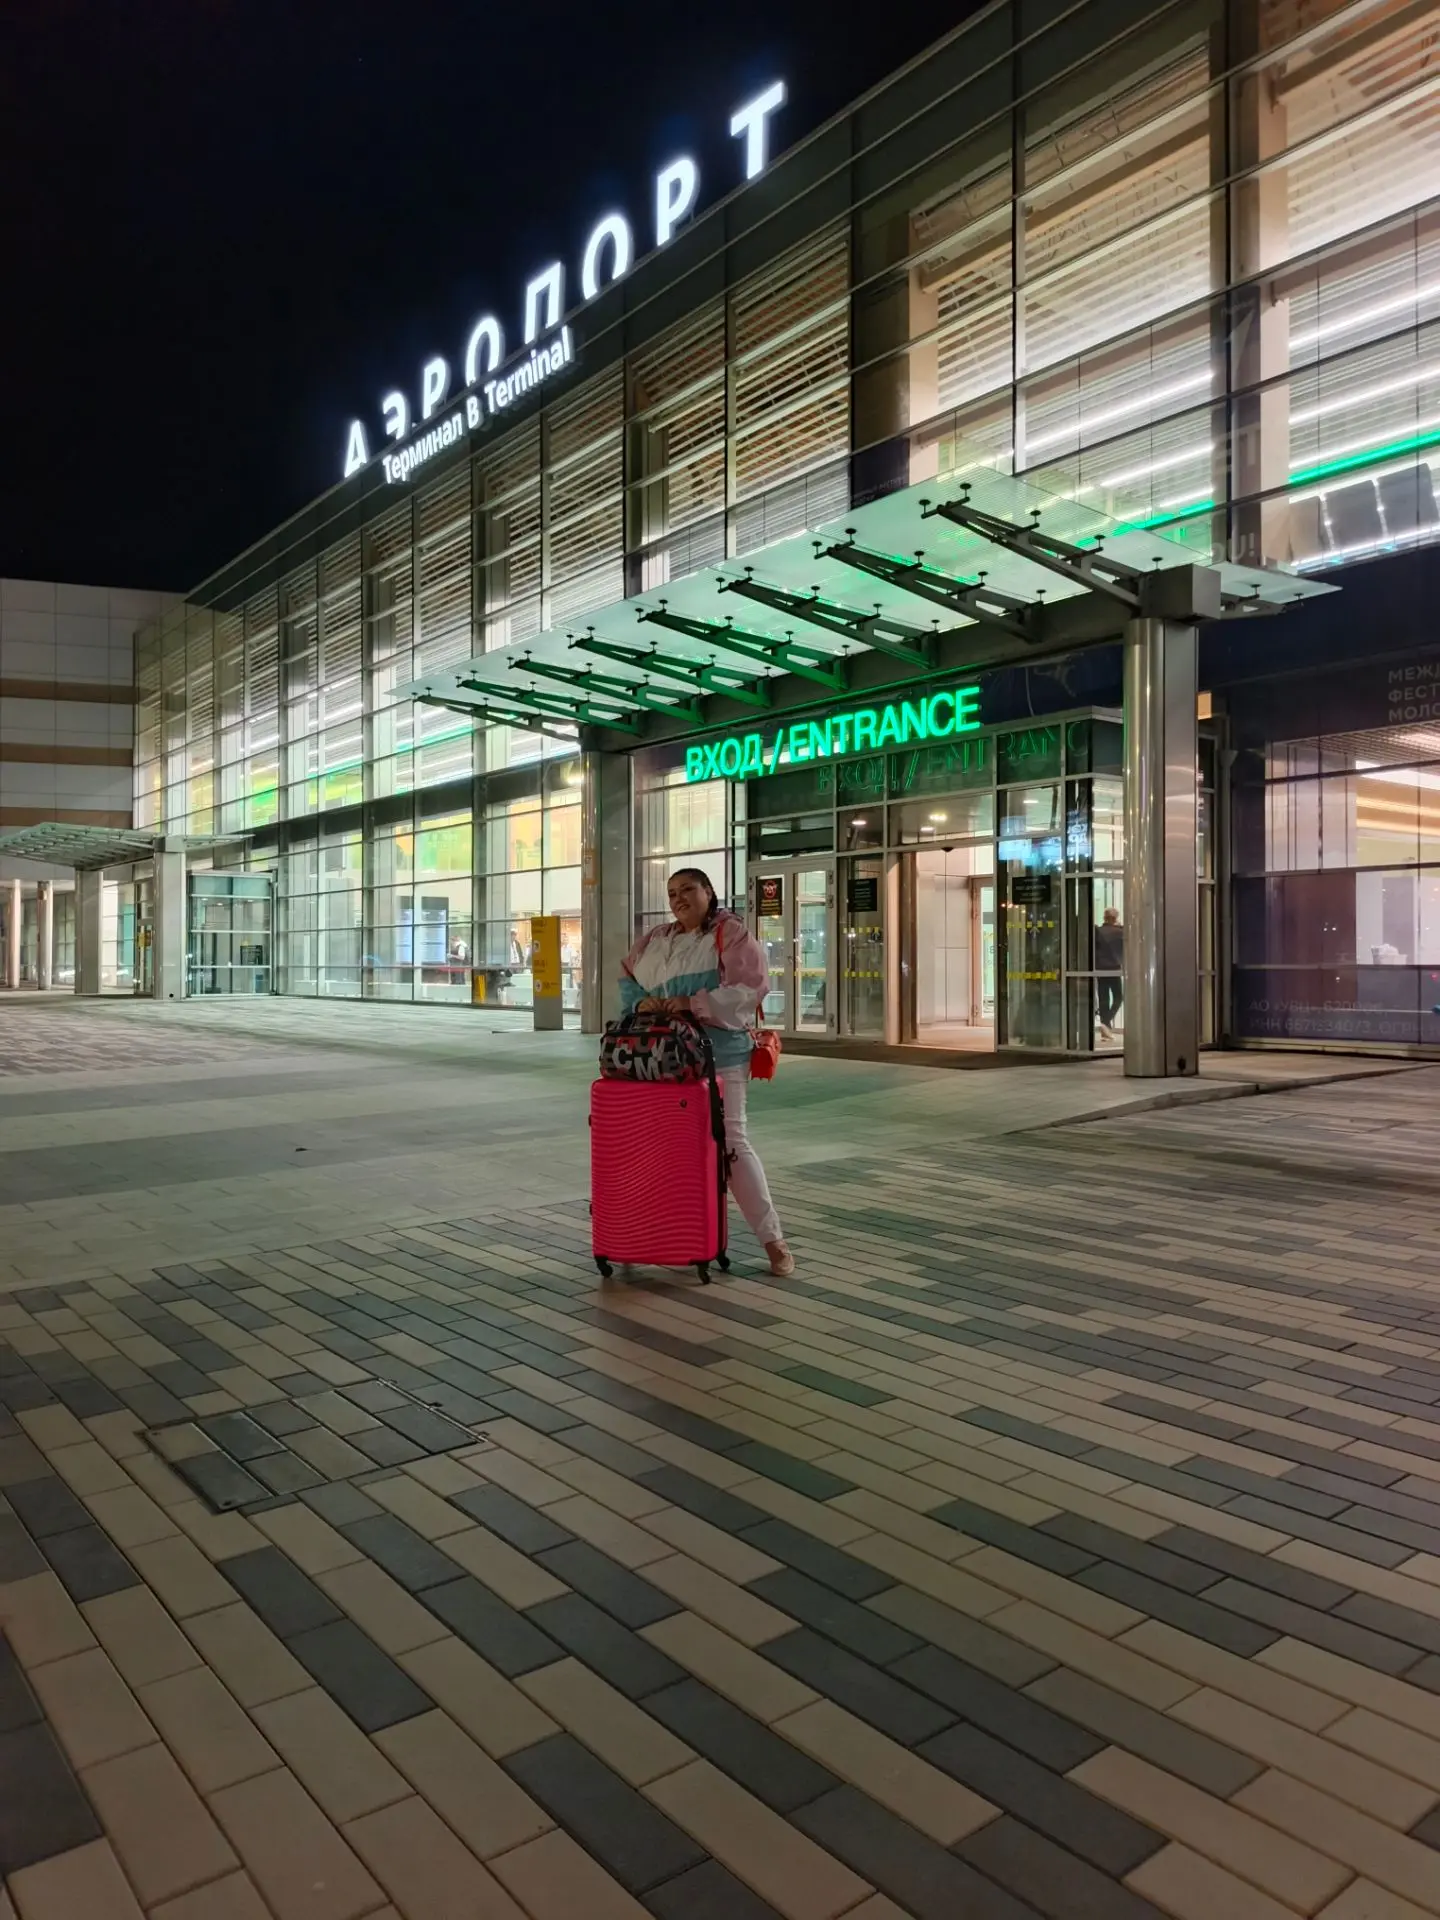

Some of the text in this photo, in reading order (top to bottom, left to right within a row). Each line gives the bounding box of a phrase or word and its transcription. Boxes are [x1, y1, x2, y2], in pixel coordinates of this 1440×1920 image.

[343, 81, 785, 478] АЭРОПОРТ
[382, 411, 464, 484] Терминал
[484, 325, 571, 414] Terminal
